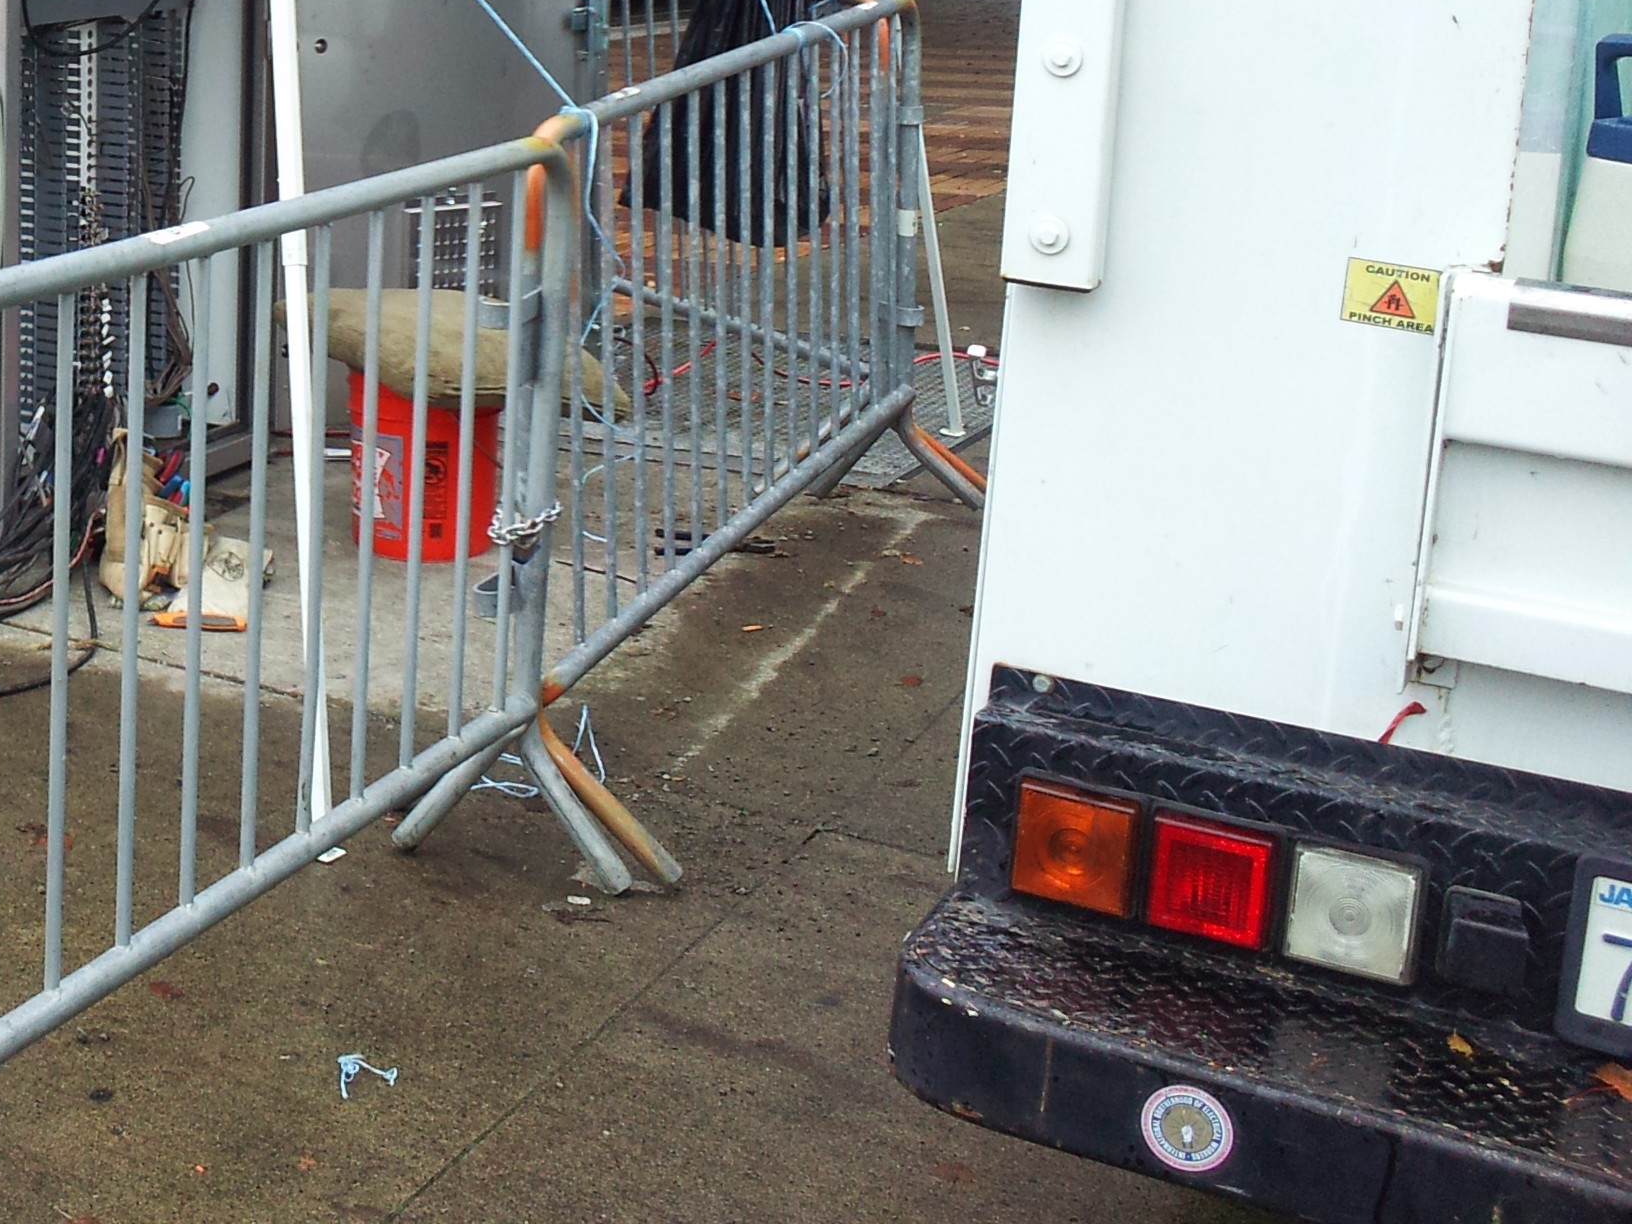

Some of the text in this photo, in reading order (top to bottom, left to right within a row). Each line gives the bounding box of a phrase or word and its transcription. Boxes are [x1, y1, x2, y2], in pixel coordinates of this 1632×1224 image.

[1365, 264, 1431, 283] CAUTION
[1349, 311, 1433, 333] PINCH AREA
[1154, 1096, 1193, 1119] BROTHERHOOD
[1202, 1106, 1222, 1141] ELECTRICAL
[1152, 1119, 1186, 1161] INTERNATIONAL
